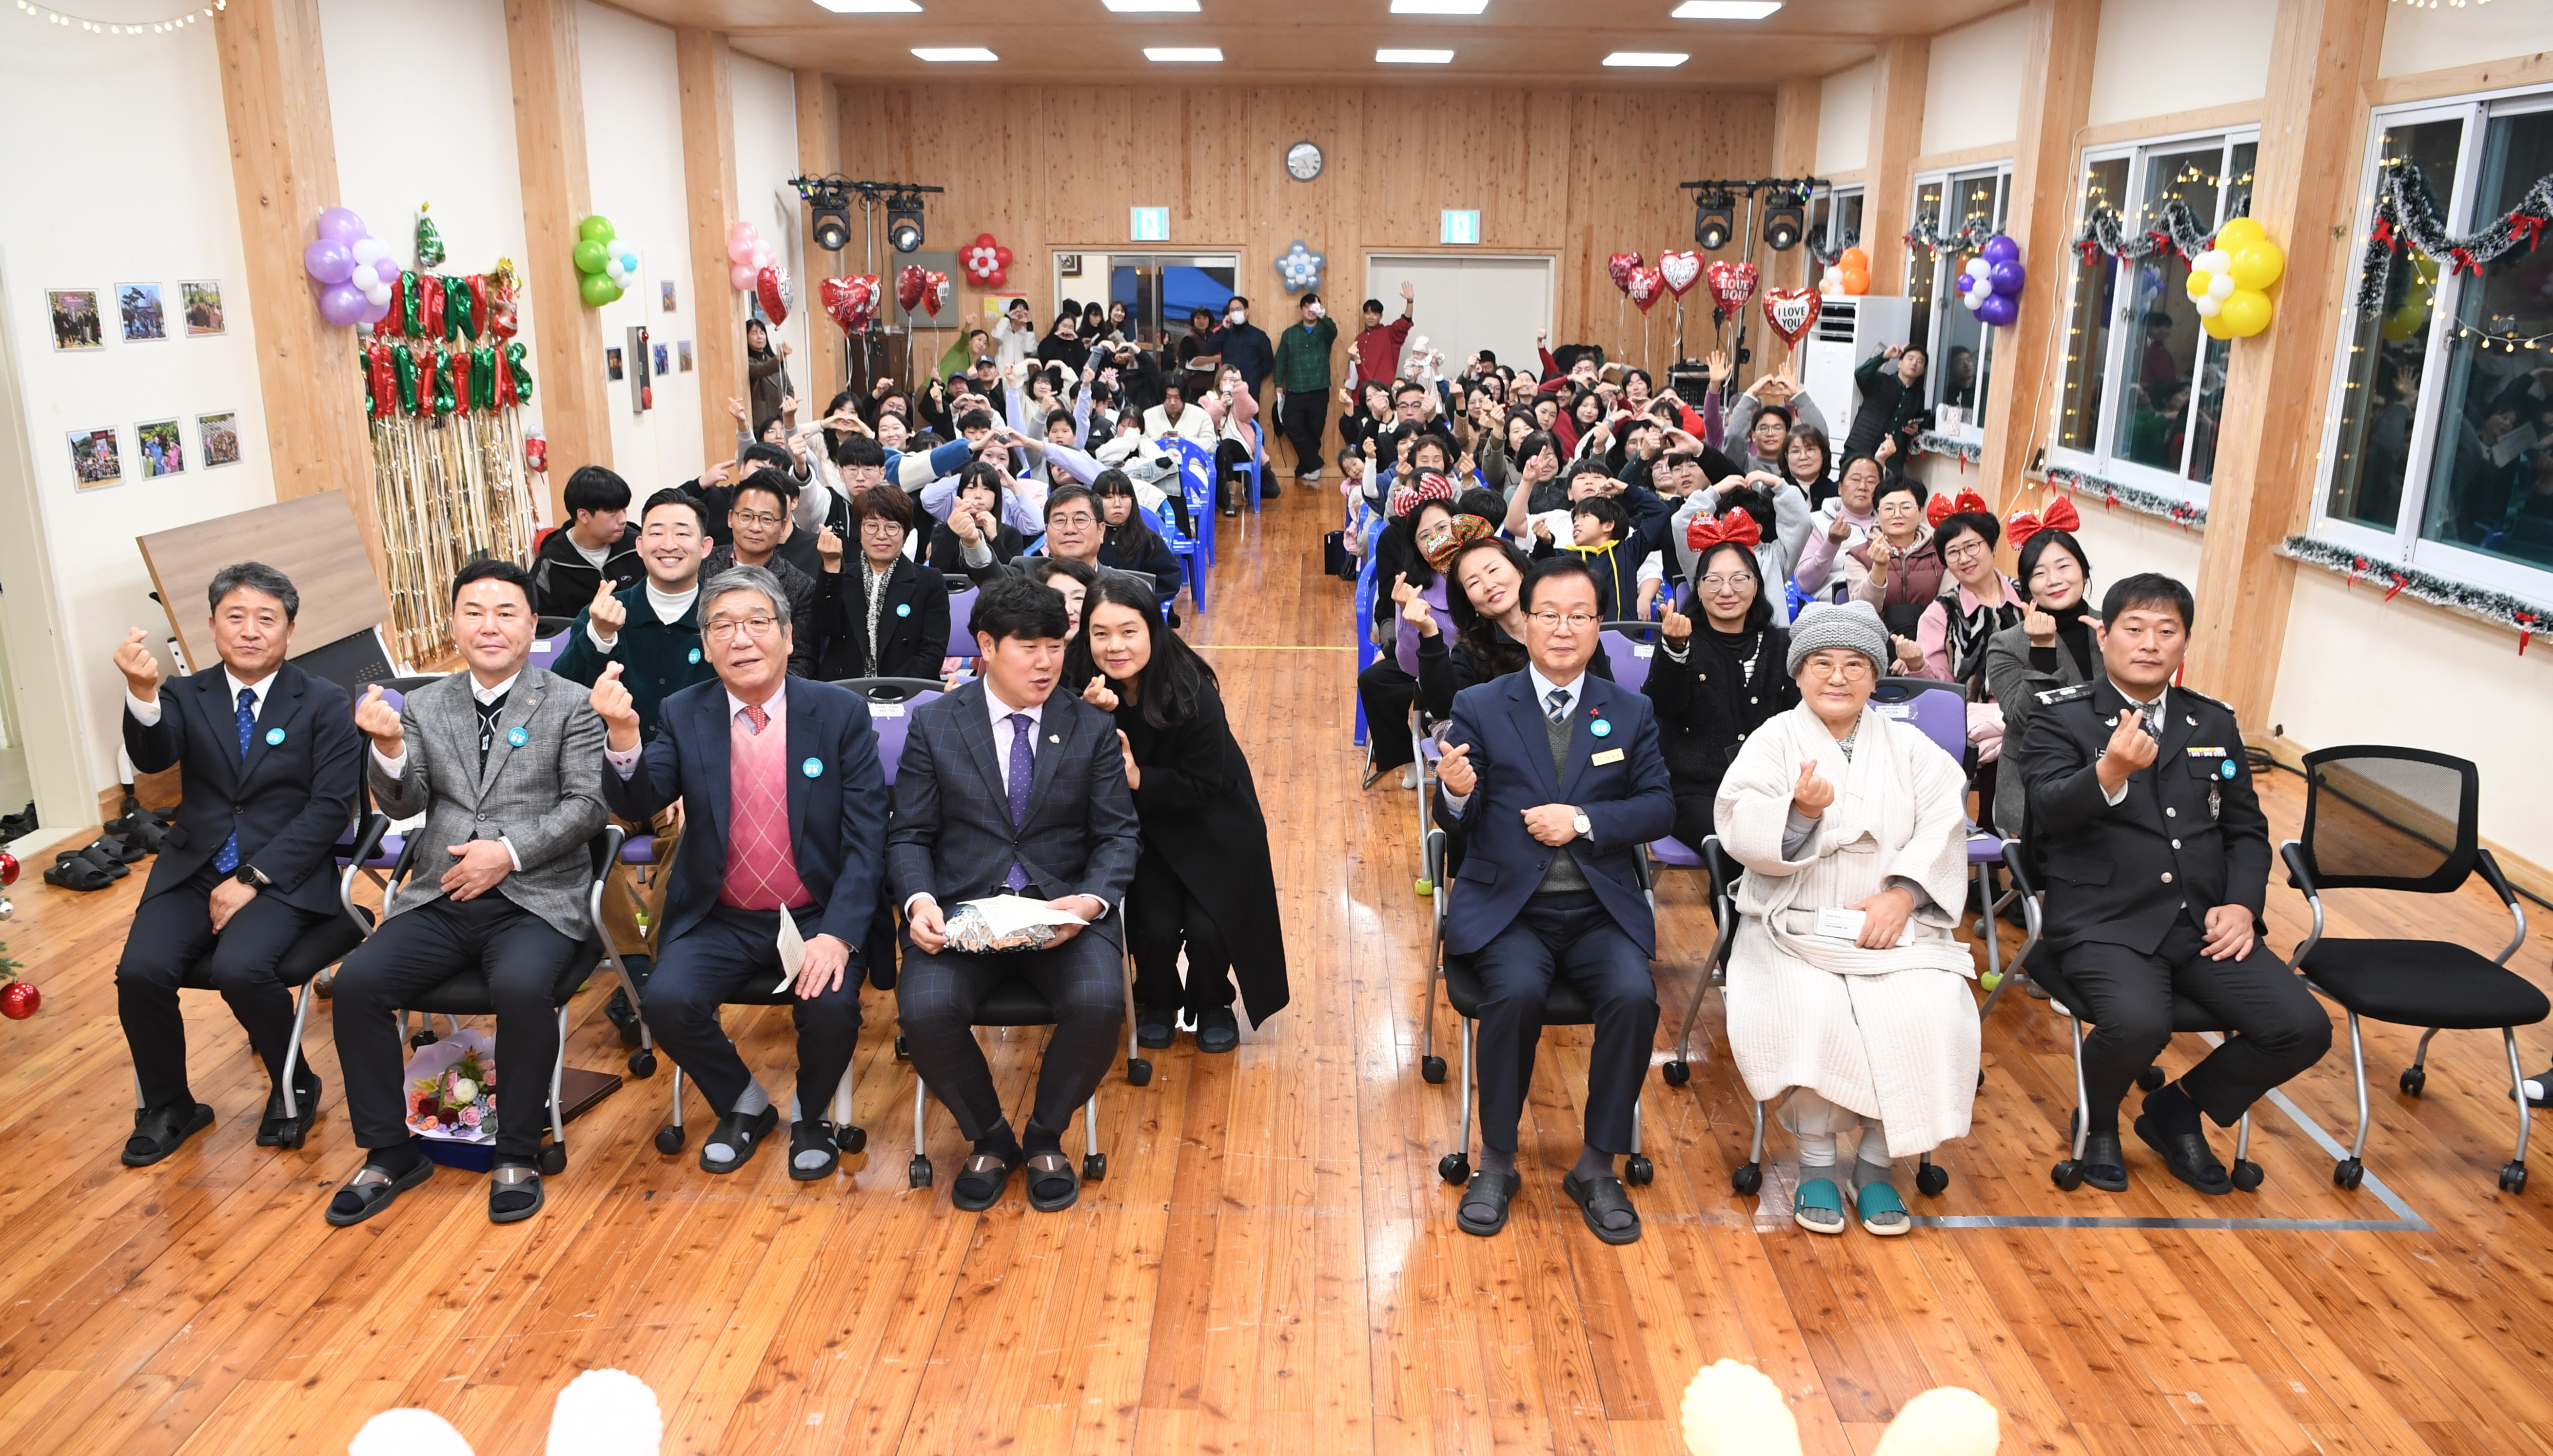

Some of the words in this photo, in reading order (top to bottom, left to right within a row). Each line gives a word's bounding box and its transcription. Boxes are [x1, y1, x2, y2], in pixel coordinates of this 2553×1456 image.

[1629, 280, 1648, 291] LOVE
[1720, 278, 1749, 291] LOVE
[1778, 307, 1781, 317] I
[1784, 306, 1806, 317] LOVE
[1782, 318, 1801, 328] YOU
